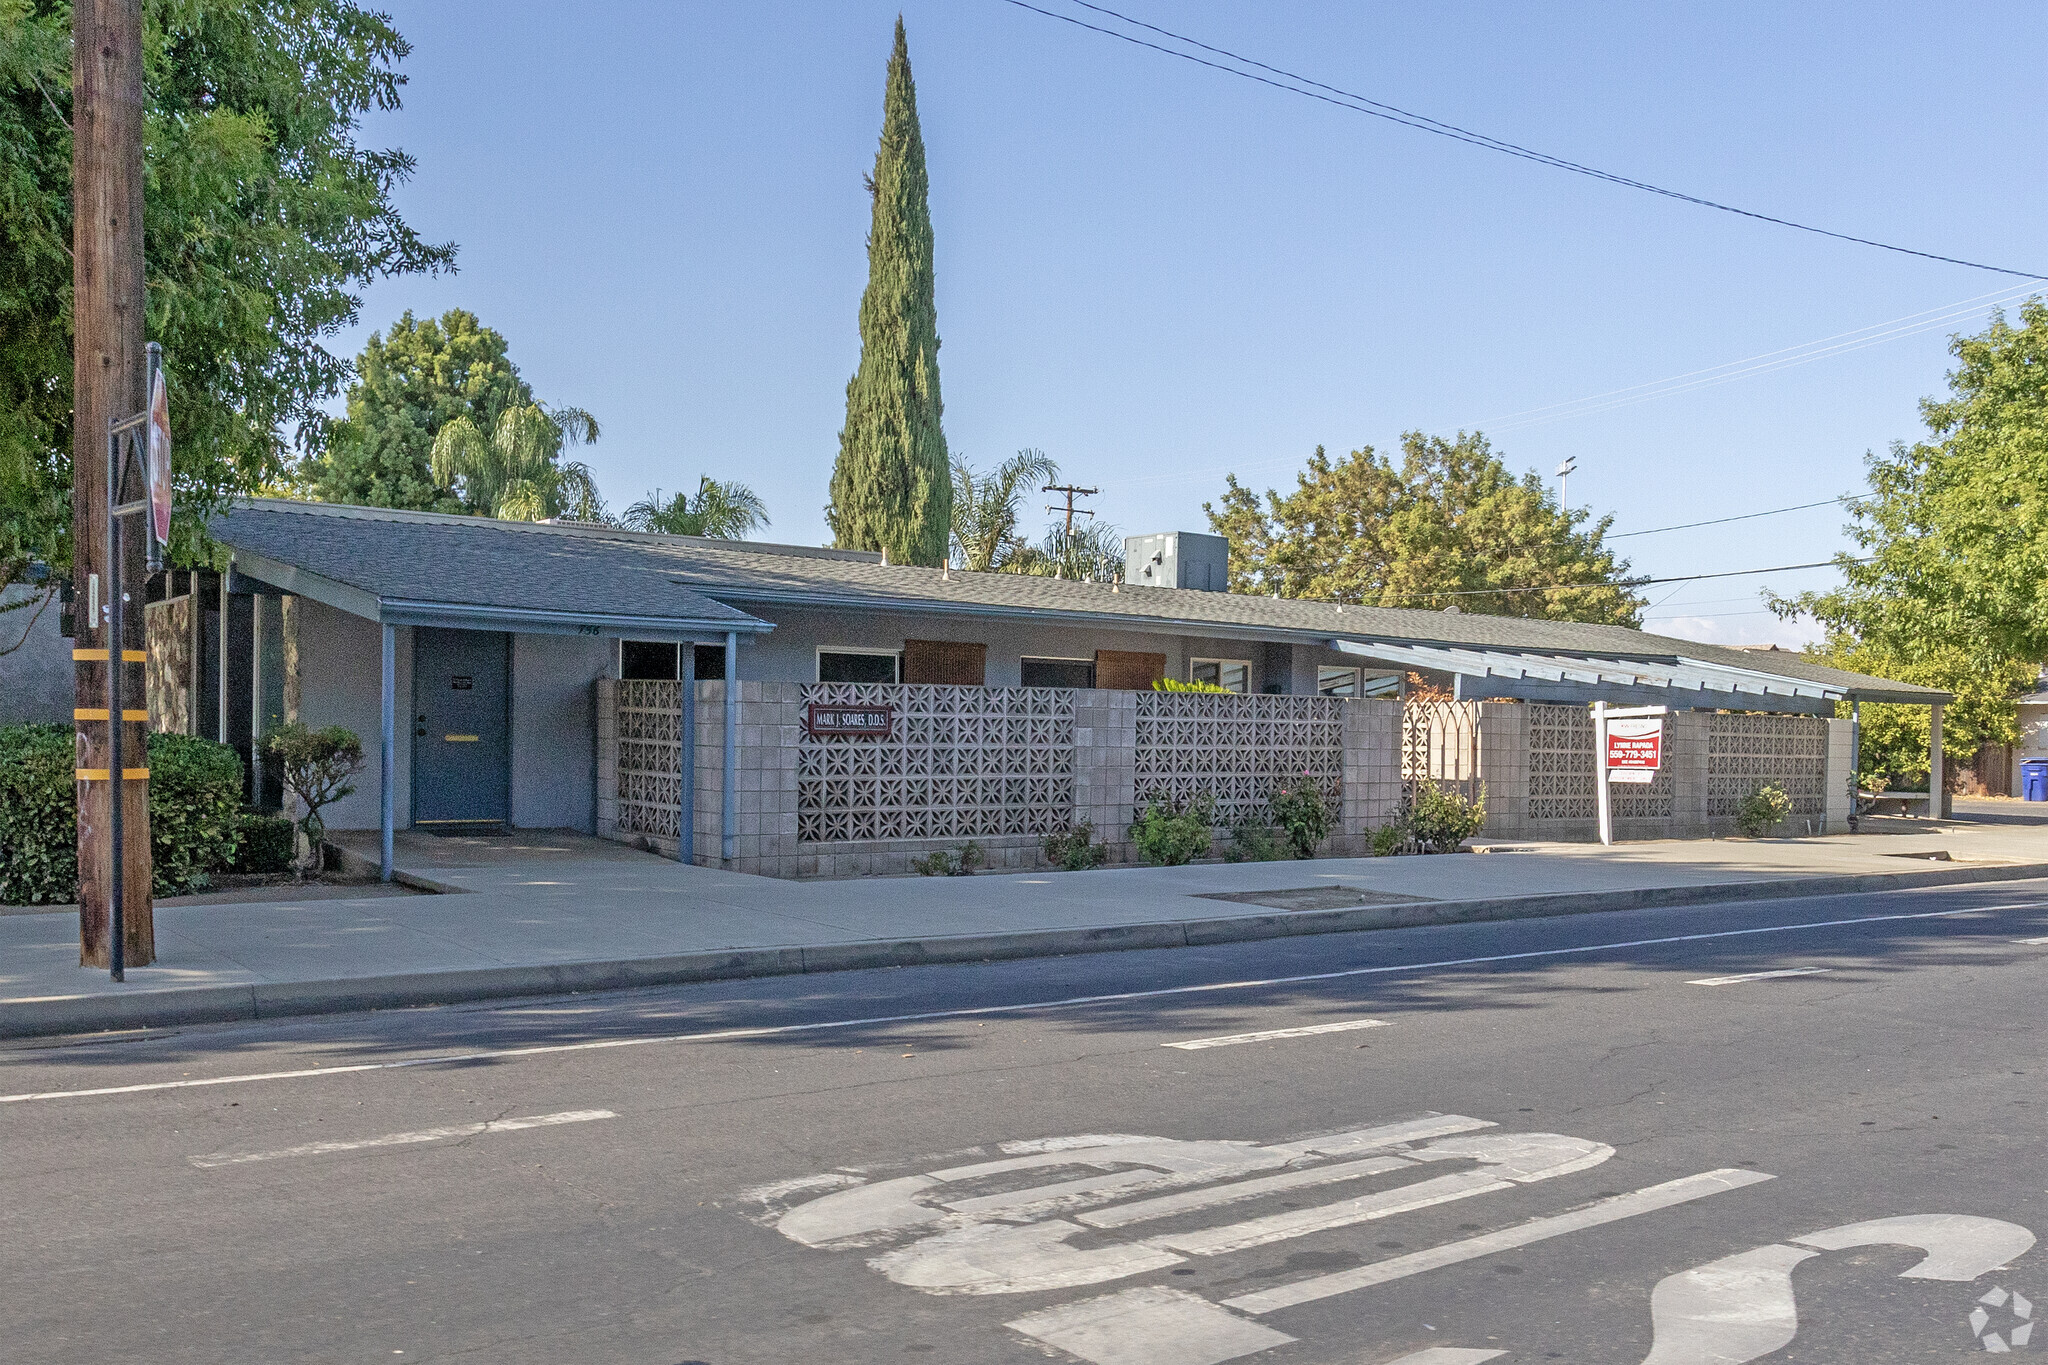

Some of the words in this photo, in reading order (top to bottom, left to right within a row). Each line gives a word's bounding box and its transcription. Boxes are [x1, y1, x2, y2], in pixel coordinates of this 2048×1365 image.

[816, 713, 834, 725] MARK
[842, 713, 866, 727] SOARES,
[868, 714, 886, 726] D.D.S.
